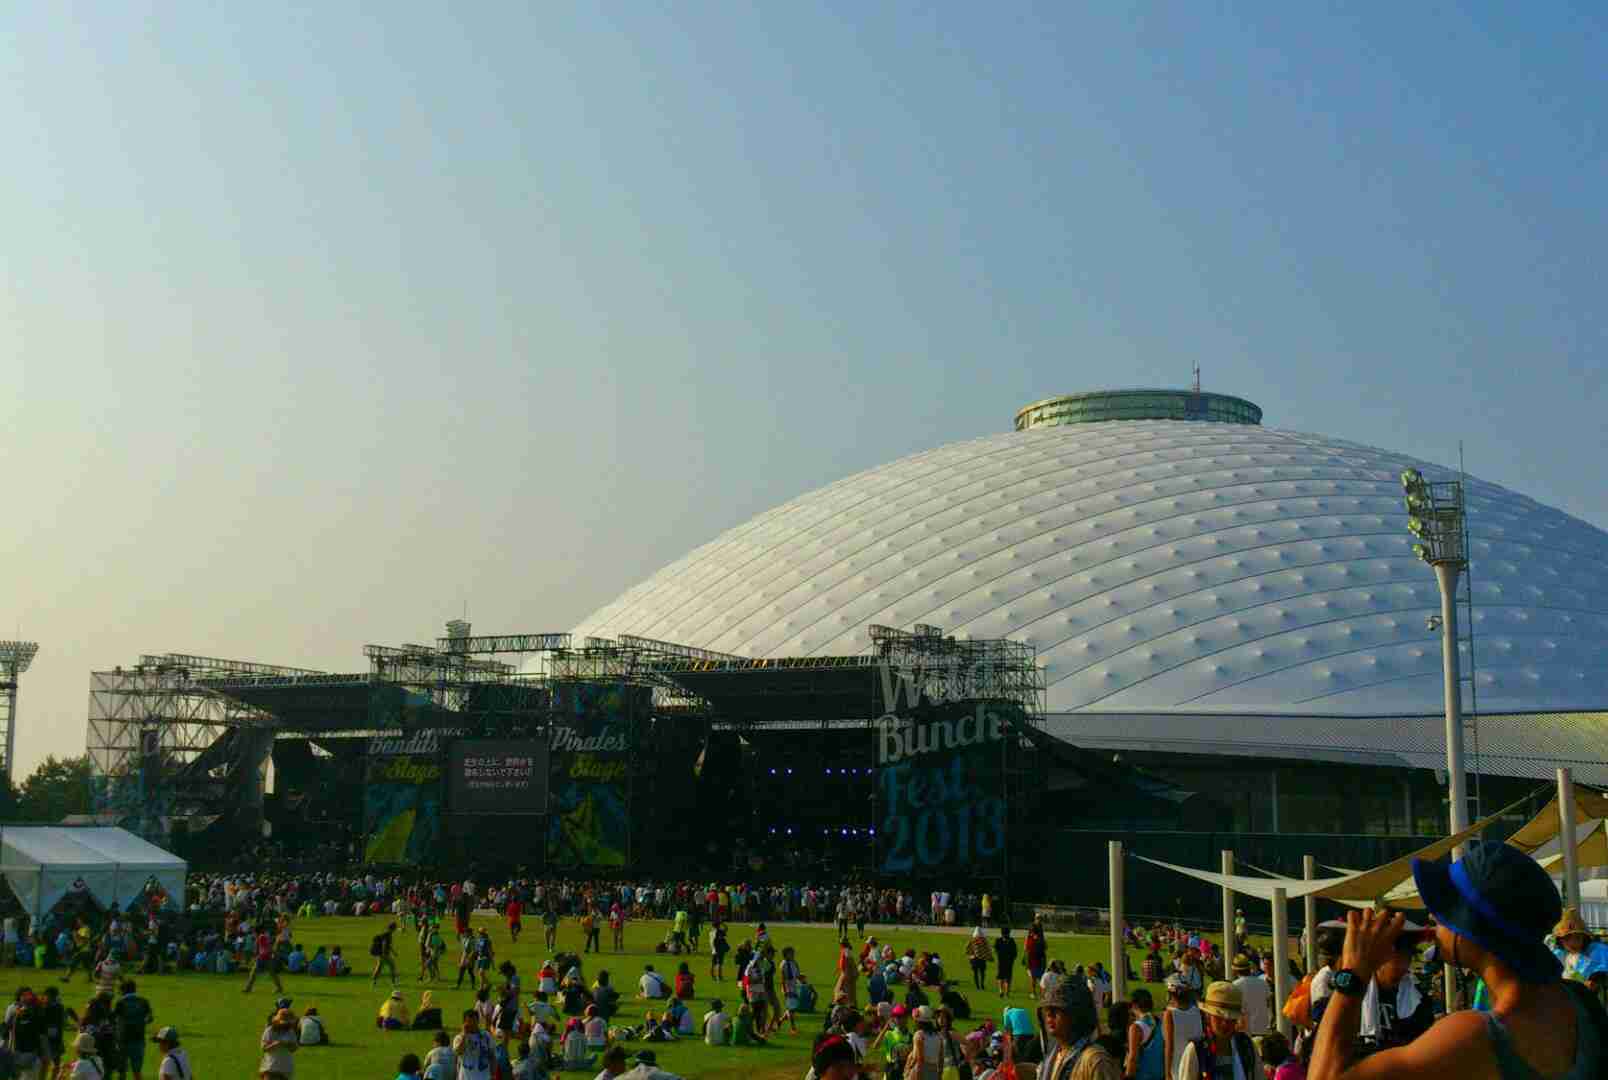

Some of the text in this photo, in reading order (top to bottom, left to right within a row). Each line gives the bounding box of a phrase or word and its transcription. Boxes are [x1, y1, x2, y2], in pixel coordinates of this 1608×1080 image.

[552, 726, 628, 752] Pirates
[876, 704, 1010, 765] Bunch
[880, 757, 972, 818] Fest
[880, 799, 1006, 874] 2013
